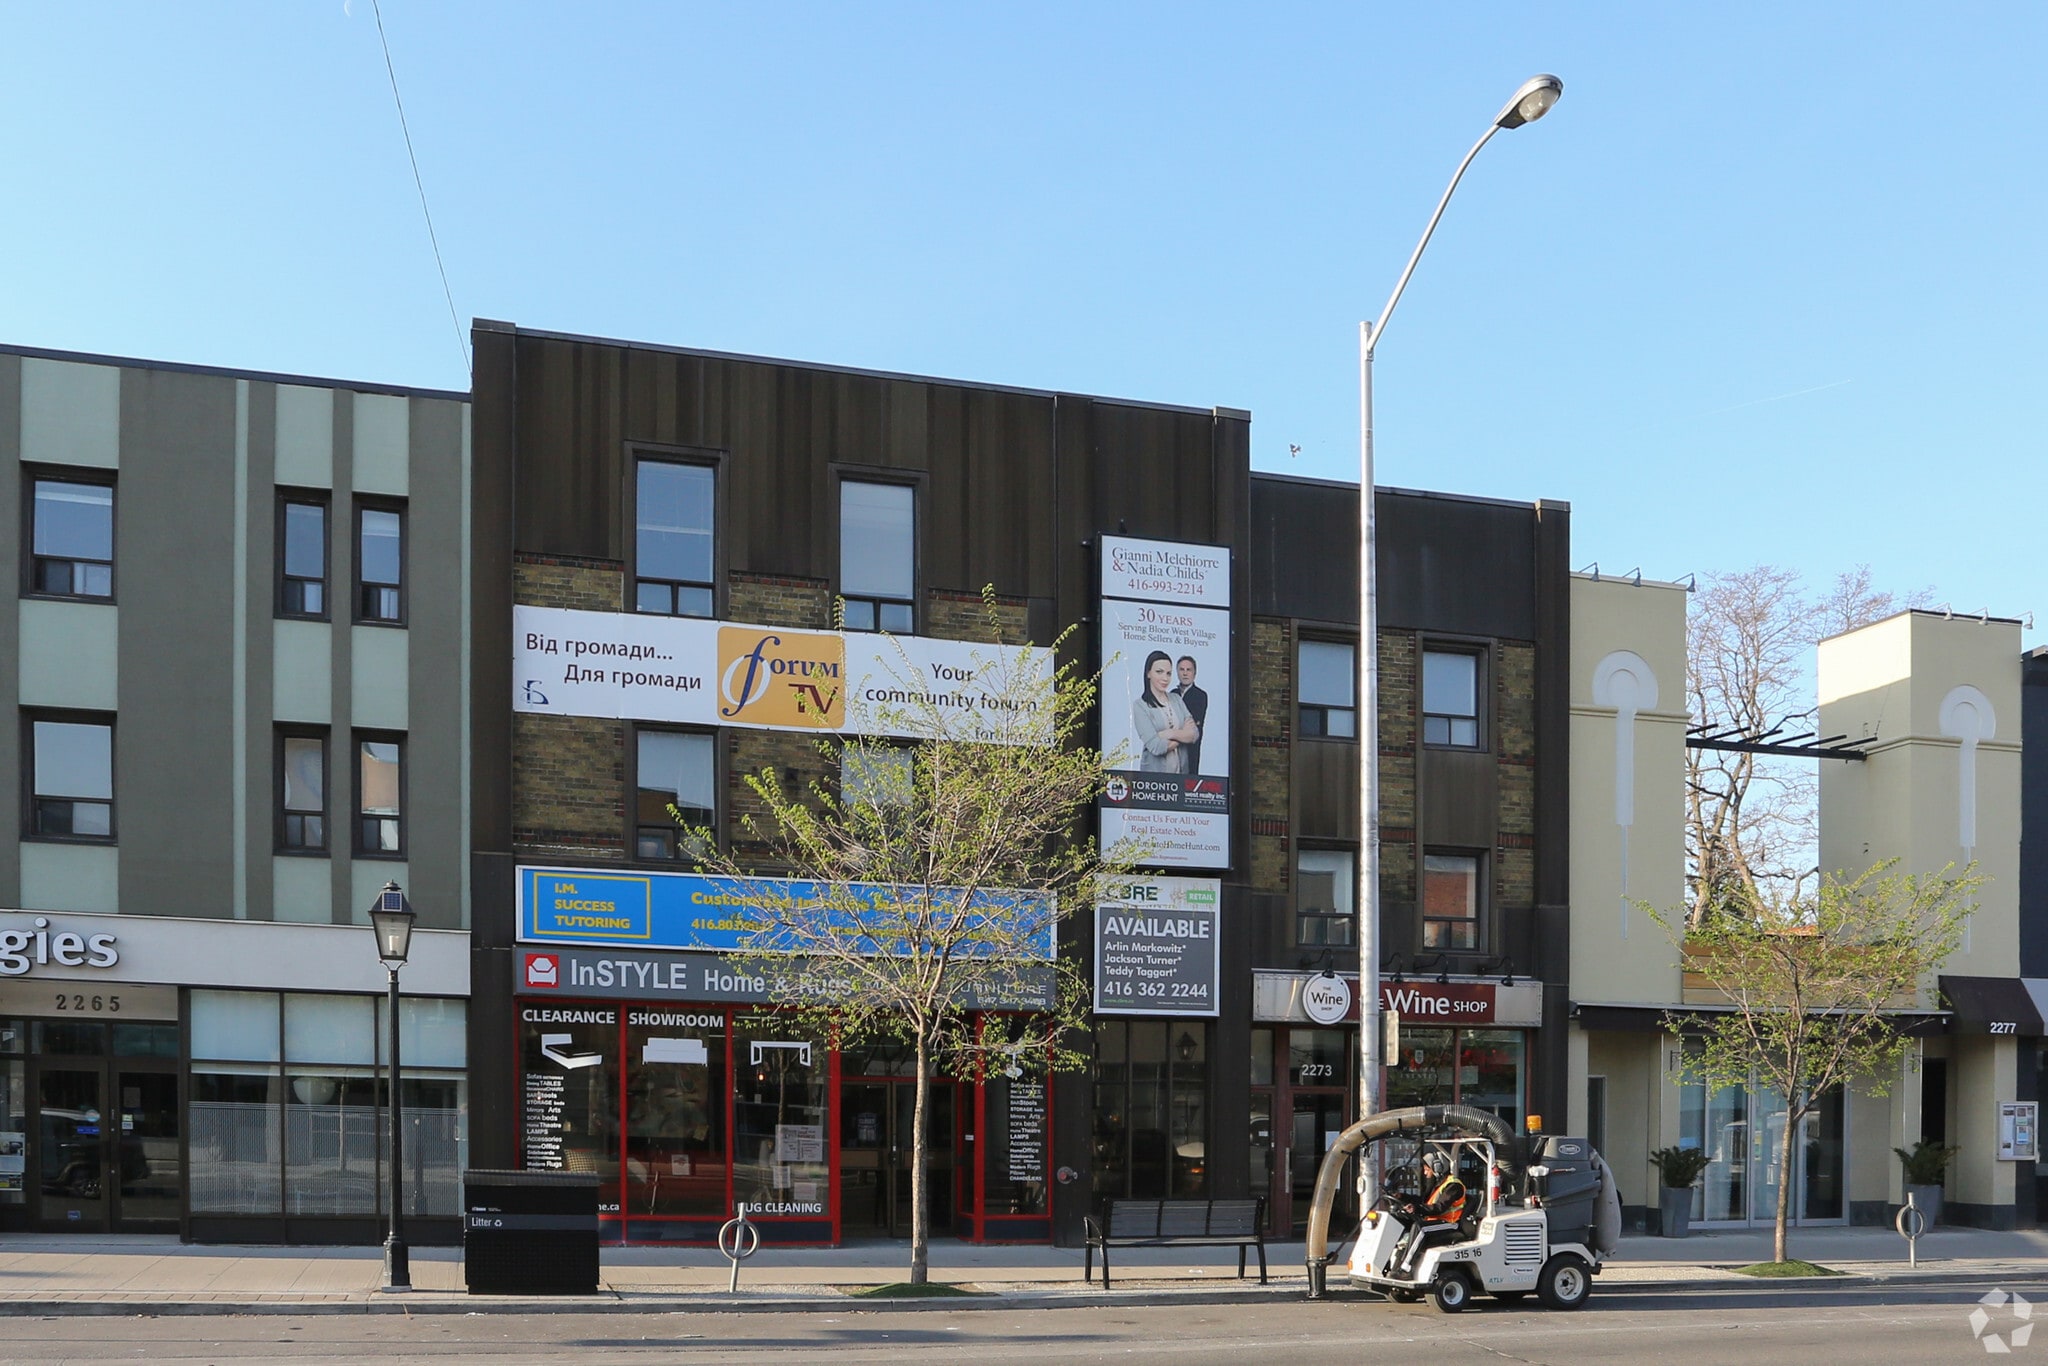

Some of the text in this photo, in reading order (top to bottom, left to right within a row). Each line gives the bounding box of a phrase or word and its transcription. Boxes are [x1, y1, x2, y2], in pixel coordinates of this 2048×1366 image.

[1112, 546, 1219, 568] Gianni Melchiorre
[1112, 559, 1125, 572] &
[1127, 561, 1162, 577] Nadia
[1128, 579, 1203, 595] 416-993-2214
[1138, 607, 1192, 627] 30 YEARS
[1118, 622, 1216, 640] Serving Bloor West Village
[526, 633, 558, 655] Від
[1123, 631, 1209, 647] Home Sellers & Buyers
[564, 664, 701, 691] Для громади
[931, 663, 973, 682] Your
[788, 683, 839, 714] TV
[1132, 781, 1178, 792] TORONTO
[1132, 791, 1178, 802] HOME HUNT
[1122, 812, 1210, 826] Contact Us For All Your
[1131, 825, 1196, 837] Real Estate Needs
[555, 882, 578, 895] I.M.
[1106, 884, 1214, 901] BRE RETAIL
[555, 899, 616, 912] SUCCESS
[555, 914, 631, 929] TUTORING
[1104, 916, 1209, 939] AVAILABLE
[0, 917, 119, 974] gies
[1105, 942, 1129, 952] Arlin
[1104, 953, 1143, 964] Jackson
[571, 958, 687, 989] InSTYLE
[704, 968, 765, 993] Home
[1105, 966, 1134, 978] Teddy
[952, 981, 1047, 995] URNITURE
[1104, 981, 1208, 997] 416 362 2244
[56, 994, 120, 1012] 2265
[1311, 991, 1343, 1006] Wine
[1385, 988, 1450, 1015] Wine
[1453, 1000, 1488, 1013] SHOP
[522, 1009, 615, 1024] CLEARANCE
[629, 1012, 724, 1028] SHOWROOM
[1990, 1022, 2016, 1034] 2277
[1301, 1064, 1333, 1076] 2273
[765, 1202, 822, 1213] CLEANING
[472, 1216, 491, 1226] Litter
[1455, 1248, 1482, 1260] 315 16
